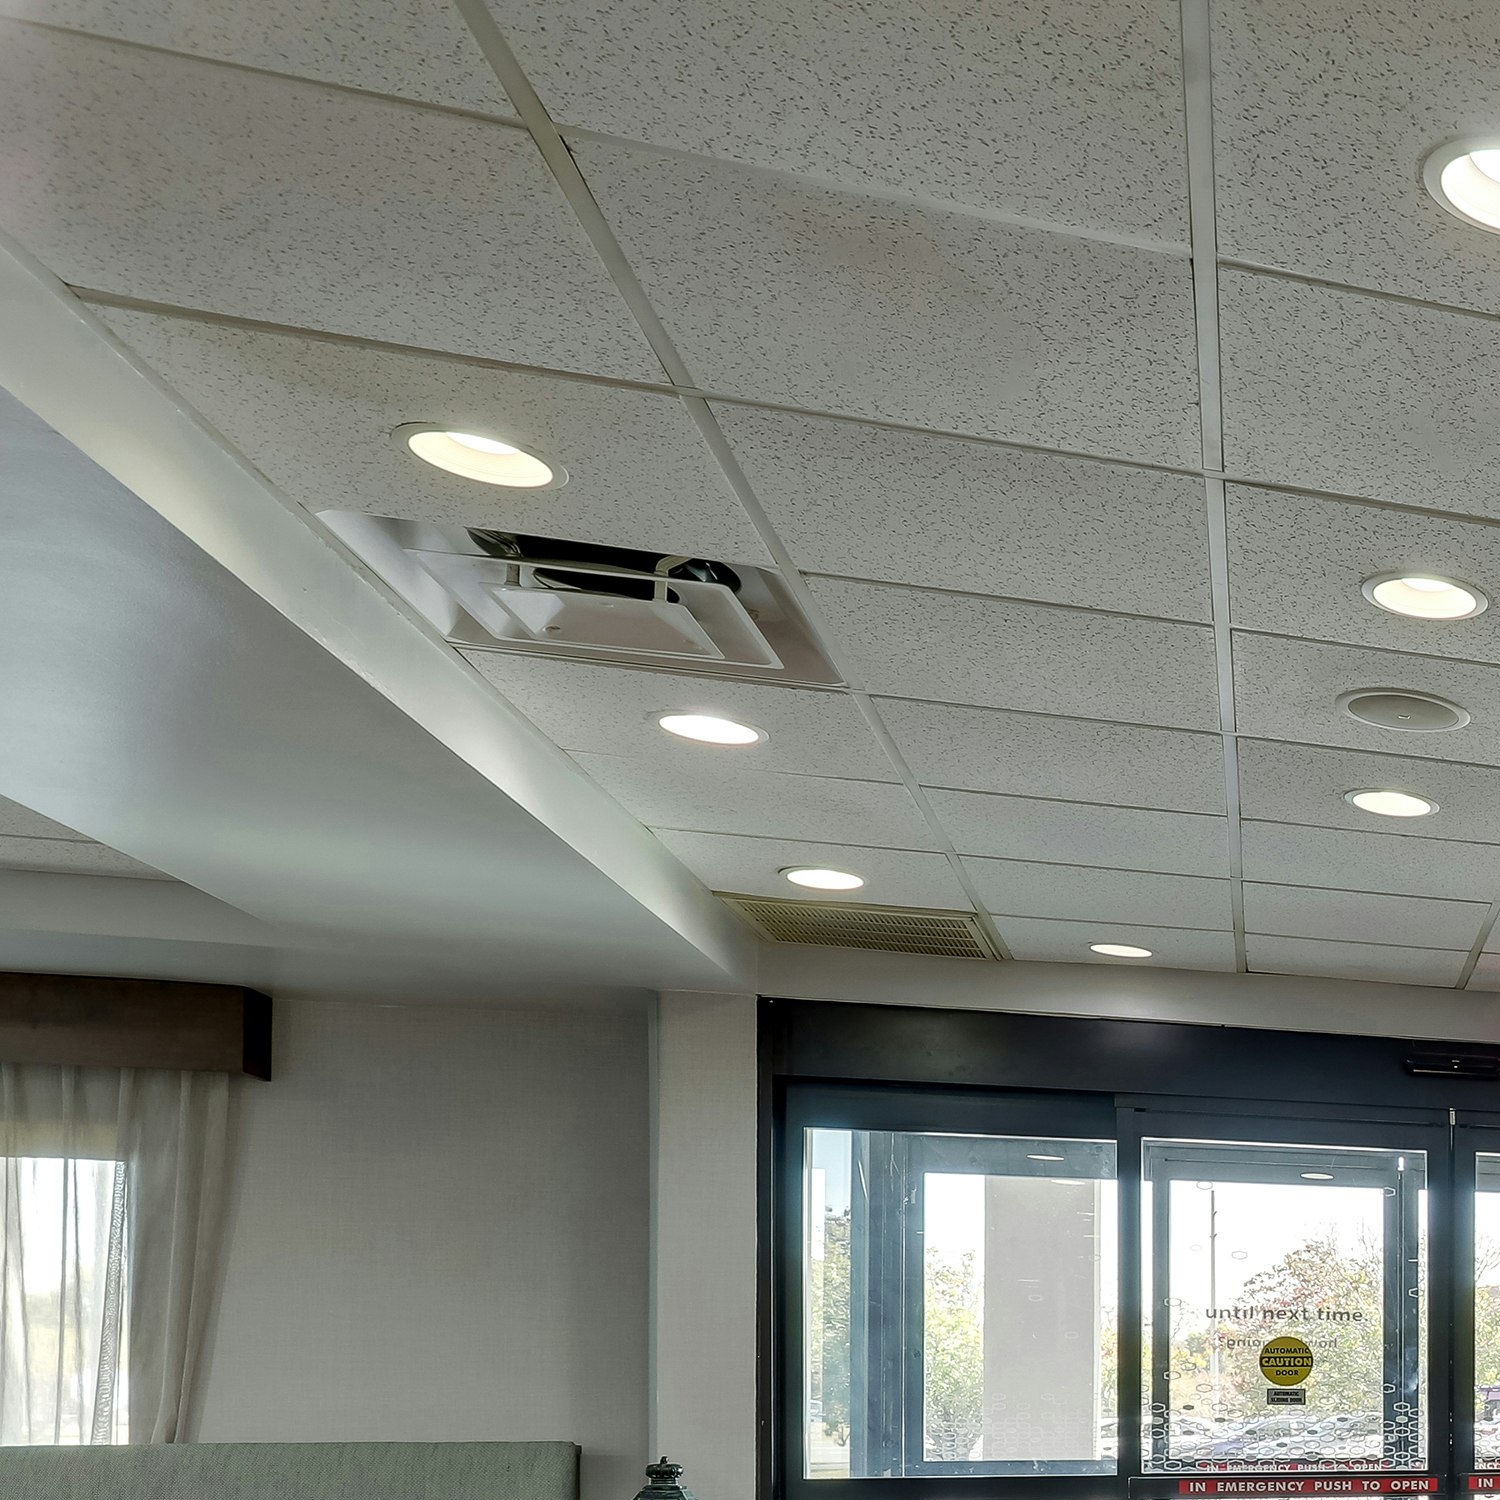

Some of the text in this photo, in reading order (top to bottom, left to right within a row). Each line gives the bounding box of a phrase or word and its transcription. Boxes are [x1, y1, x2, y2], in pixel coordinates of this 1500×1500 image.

[1205, 1305, 1369, 1323] until next time.
[1264, 1347, 1310, 1355] AUTOMATIC
[1262, 1357, 1312, 1367] CAUTION
[1189, 1480, 1429, 1493] IN EMERGENCY PUSH TO OPEN
[1478, 1478, 1494, 1488] IN
